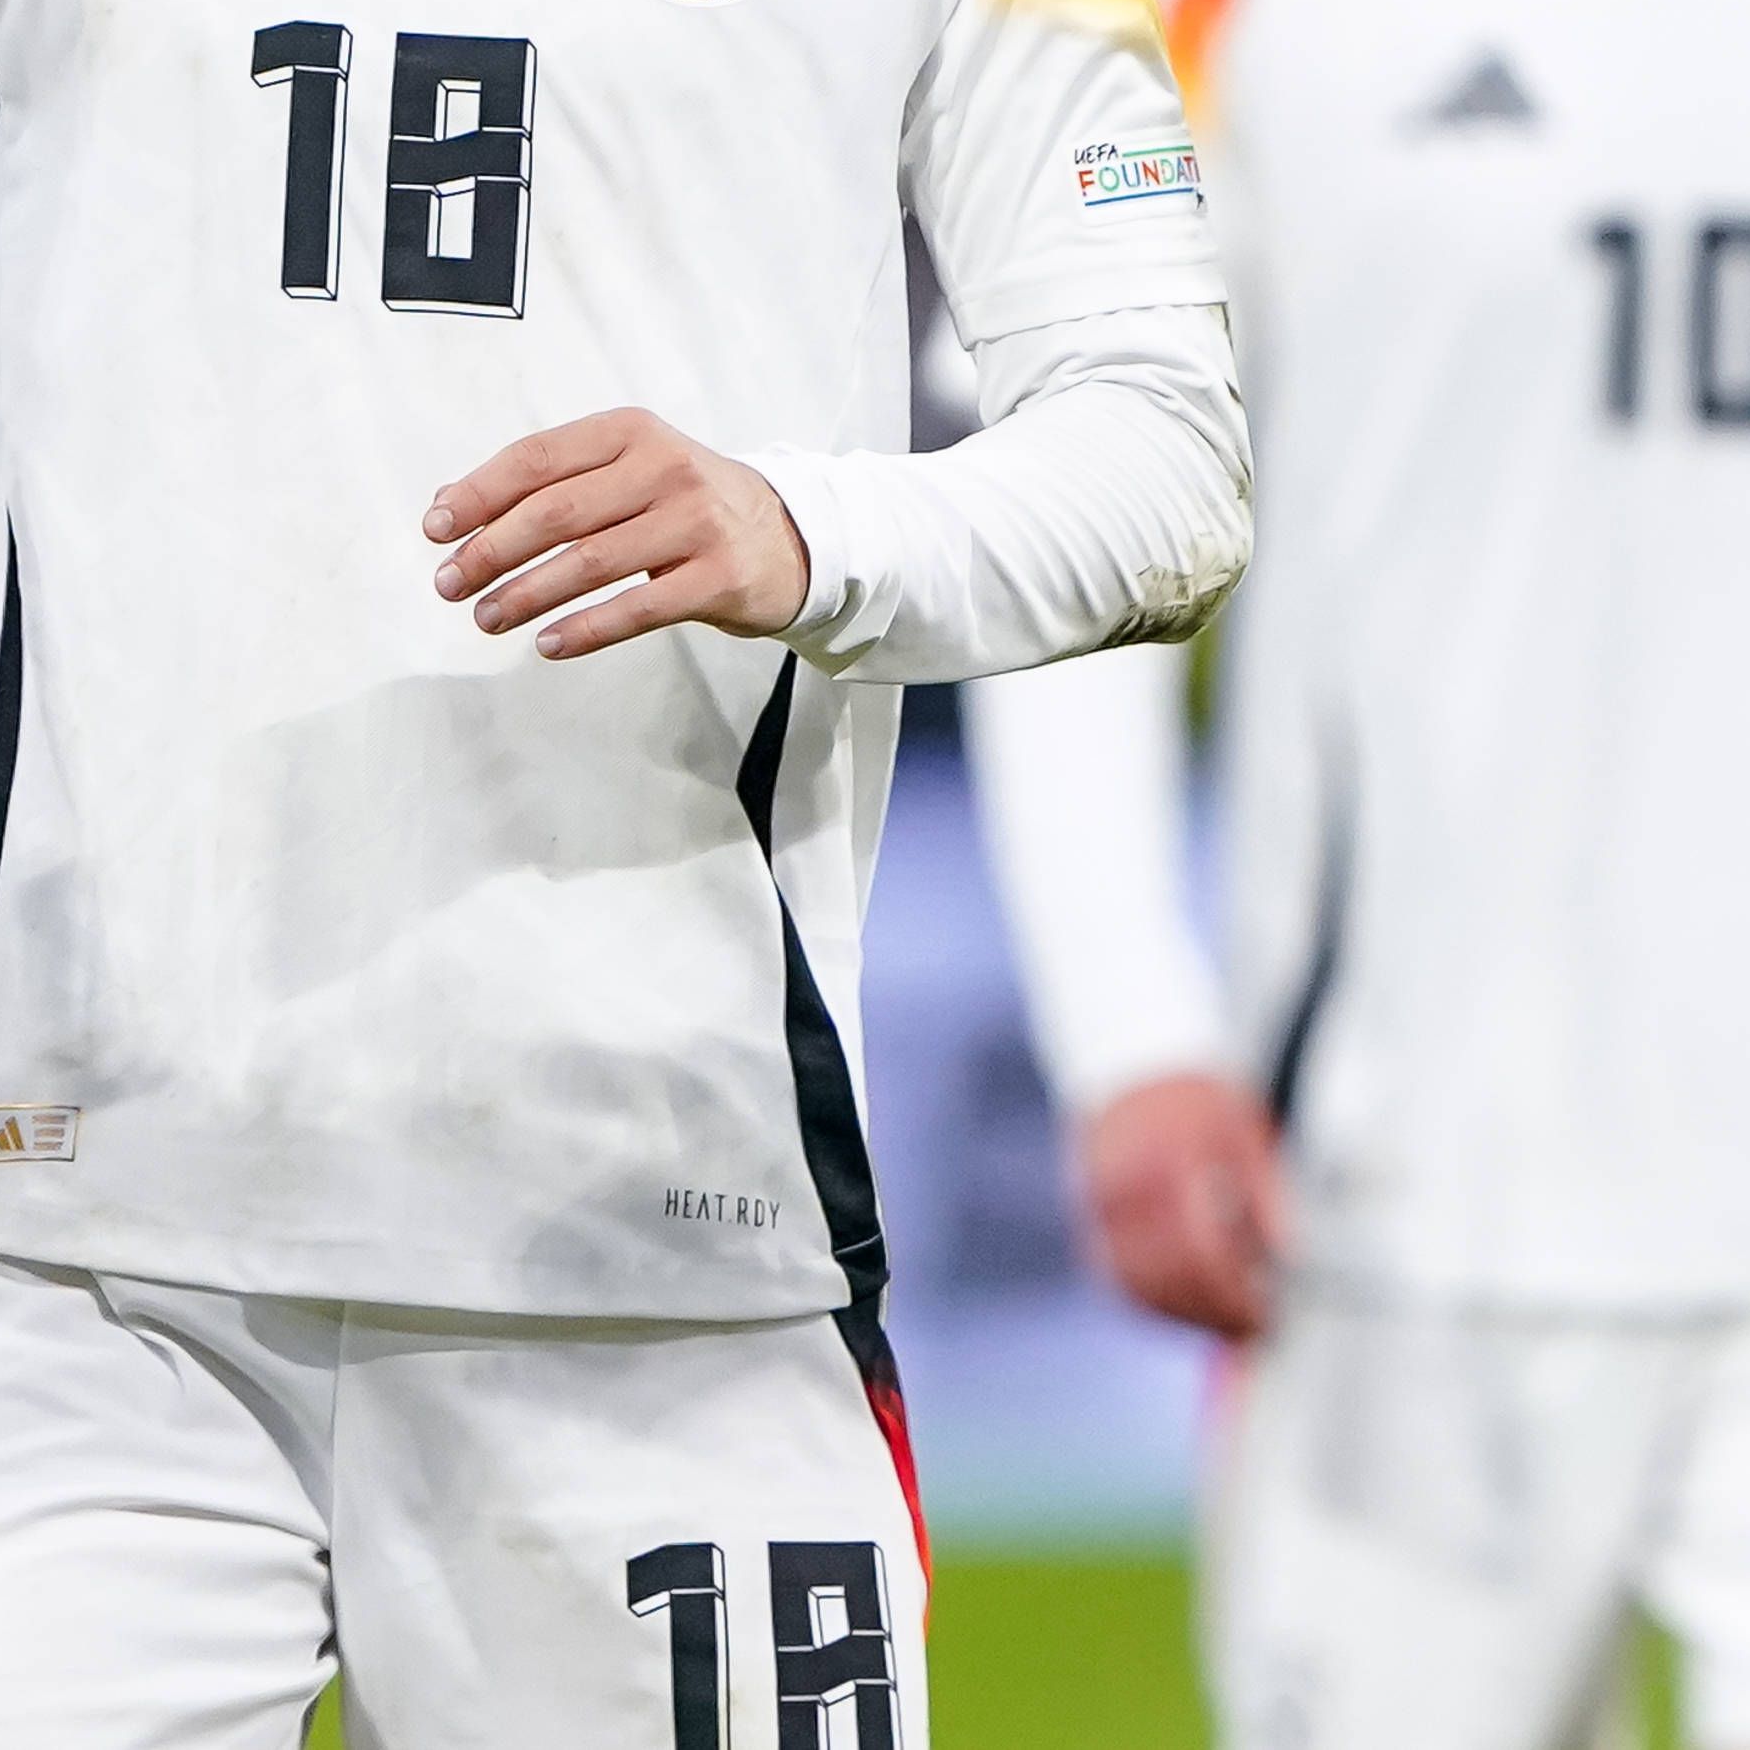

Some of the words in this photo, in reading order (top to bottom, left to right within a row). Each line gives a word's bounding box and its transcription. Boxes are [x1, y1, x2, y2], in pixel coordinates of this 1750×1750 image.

[251, 20, 537, 319] 18
[1074, 143, 1119, 165] UEFA
[626, 1541, 904, 1750] 18
